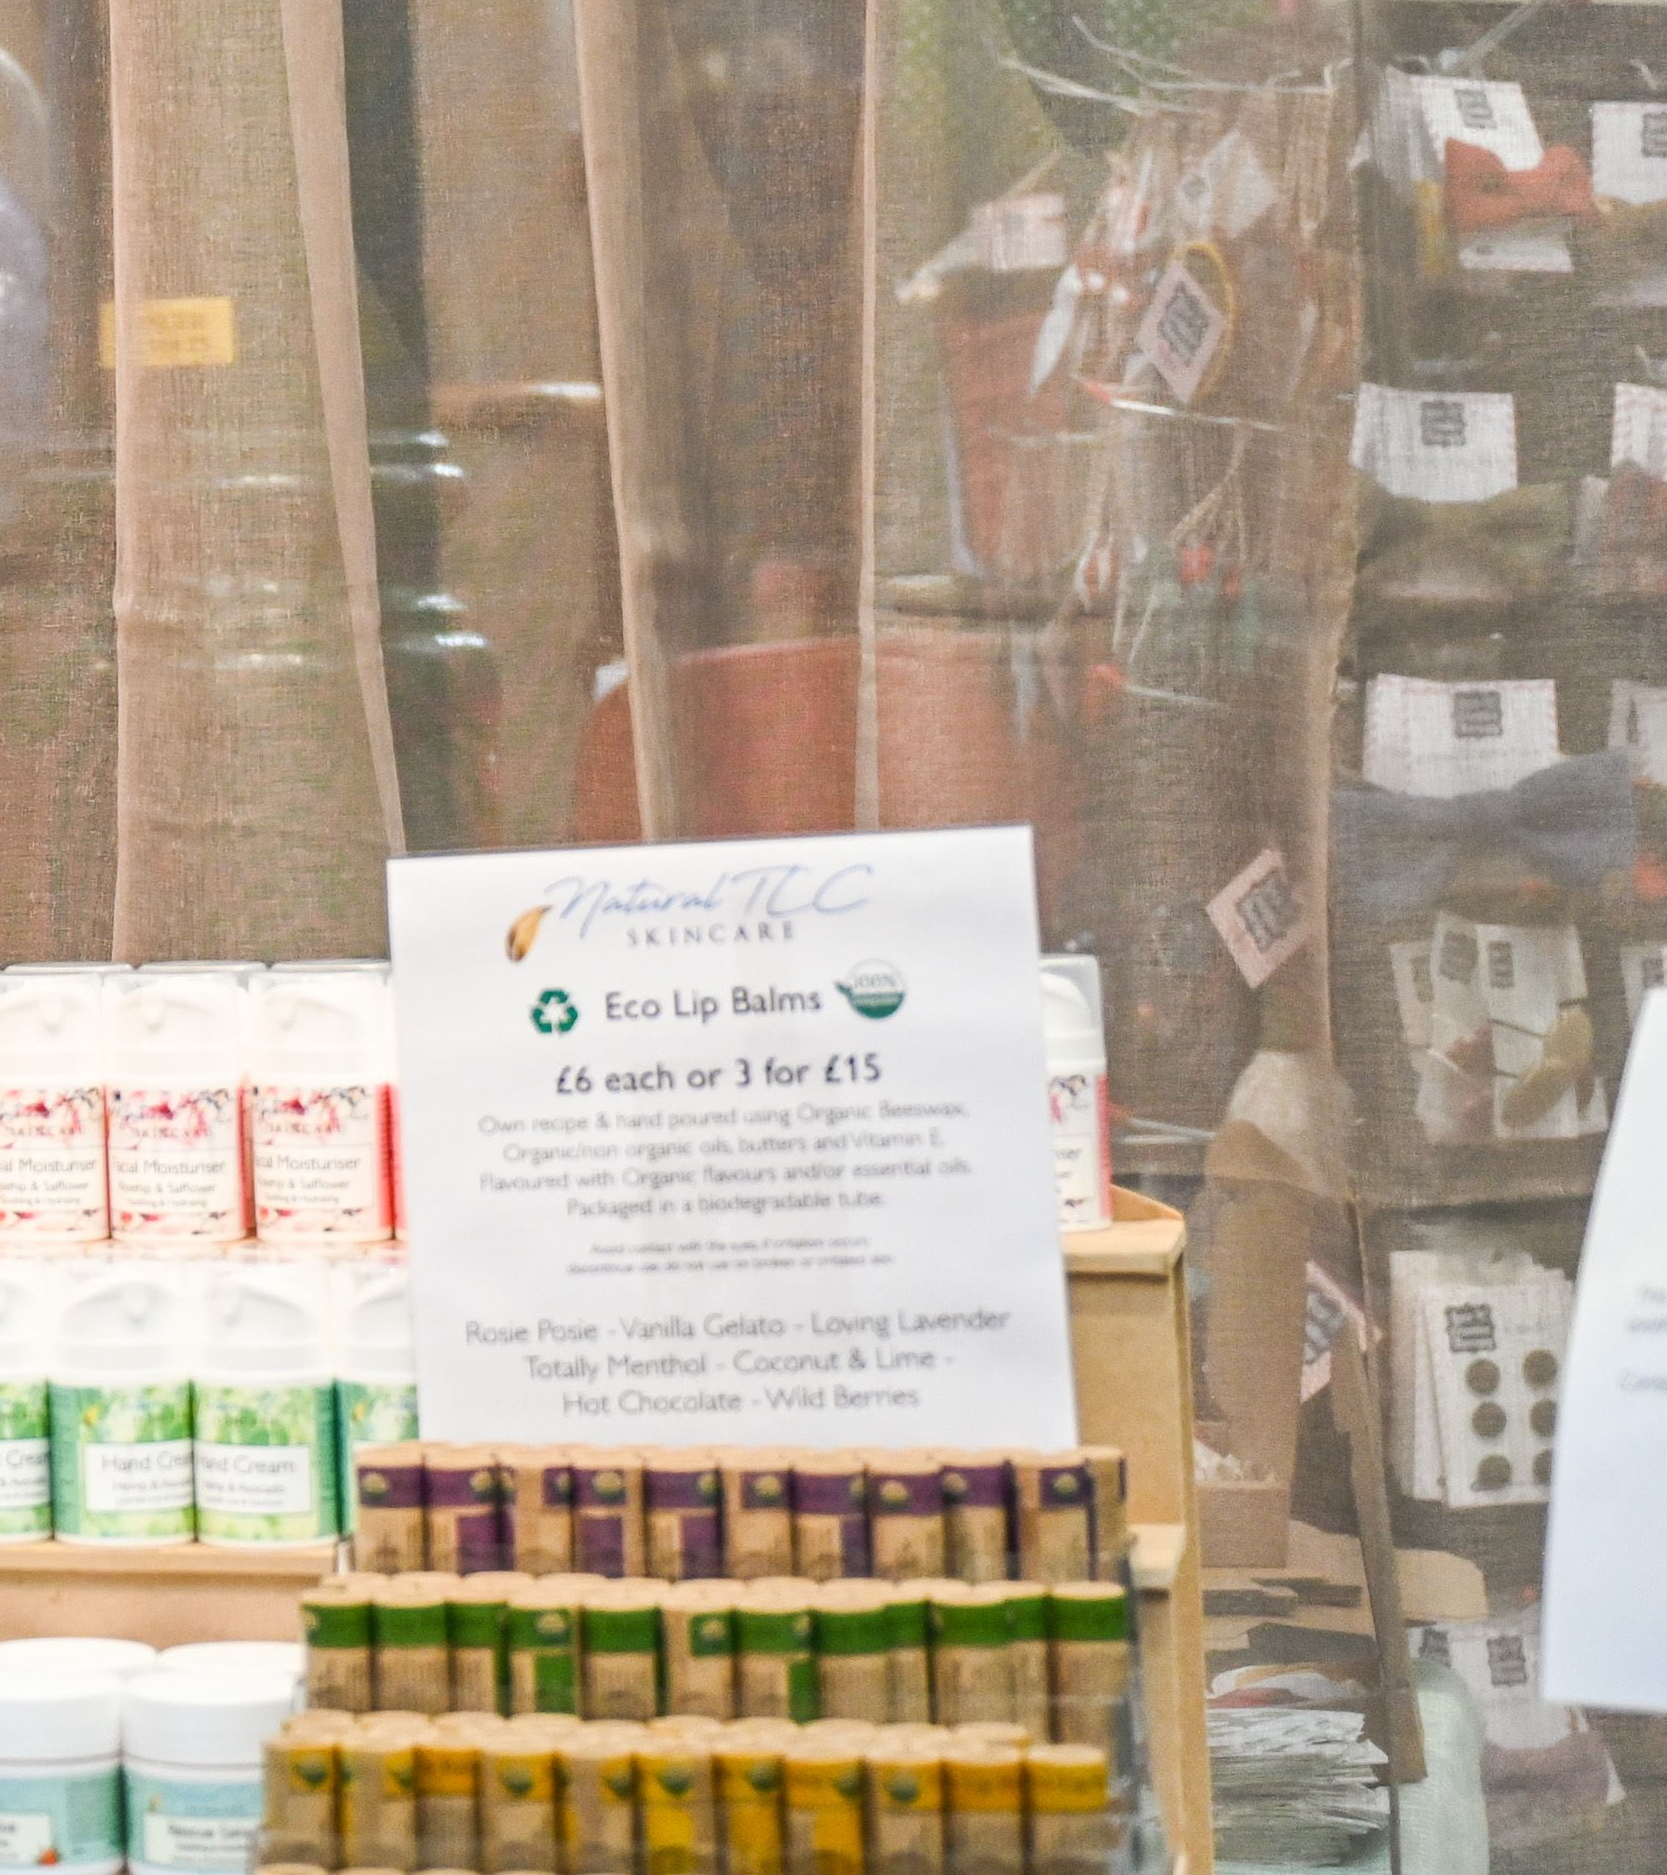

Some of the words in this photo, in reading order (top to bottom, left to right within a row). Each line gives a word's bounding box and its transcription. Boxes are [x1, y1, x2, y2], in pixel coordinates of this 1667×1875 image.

[544, 873, 727, 940] Natural
[731, 864, 873, 917] TLC
[628, 921, 795, 947] SKINCARE
[605, 991, 660, 1021] Eco
[674, 989, 719, 1024] Lip
[732, 986, 820, 1013] Balms
[556, 1066, 592, 1094] £6
[605, 1063, 674, 1092] each
[687, 1067, 721, 1086] or
[736, 1058, 751, 1086] 3
[765, 1057, 808, 1085] for
[825, 1052, 882, 1083] £15
[478, 1115, 524, 1136] Own
[615, 1109, 660, 1129] hand
[796, 1103, 871, 1126] Organic
[626, 1141, 691, 1161] organic
[813, 1132, 847, 1150] and
[575, 1170, 613, 1187] with
[621, 1167, 693, 1190] Organic
[567, 1195, 652, 1219] Packaged
[660, 1195, 675, 1212] in
[467, 1321, 529, 1344] Rosie
[538, 1320, 597, 1342] Posie
[619, 1315, 694, 1340] Vanilla
[704, 1313, 786, 1338] Gelato
[811, 1312, 889, 1339] Loving
[898, 1309, 1011, 1332] Lavender
[523, 1355, 597, 1383] Totally
[608, 1353, 705, 1377] Menthol
[733, 1349, 838, 1373] Coconut
[848, 1348, 865, 1370] &
[875, 1346, 934, 1368] Lime
[563, 1392, 608, 1415] Hot
[618, 1388, 742, 1414] Chocolate
[766, 1385, 824, 1408] Wild
[833, 1383, 920, 1408] Berries
[102, 1454, 150, 1471] Hand
[233, 1456, 297, 1475] Cream
